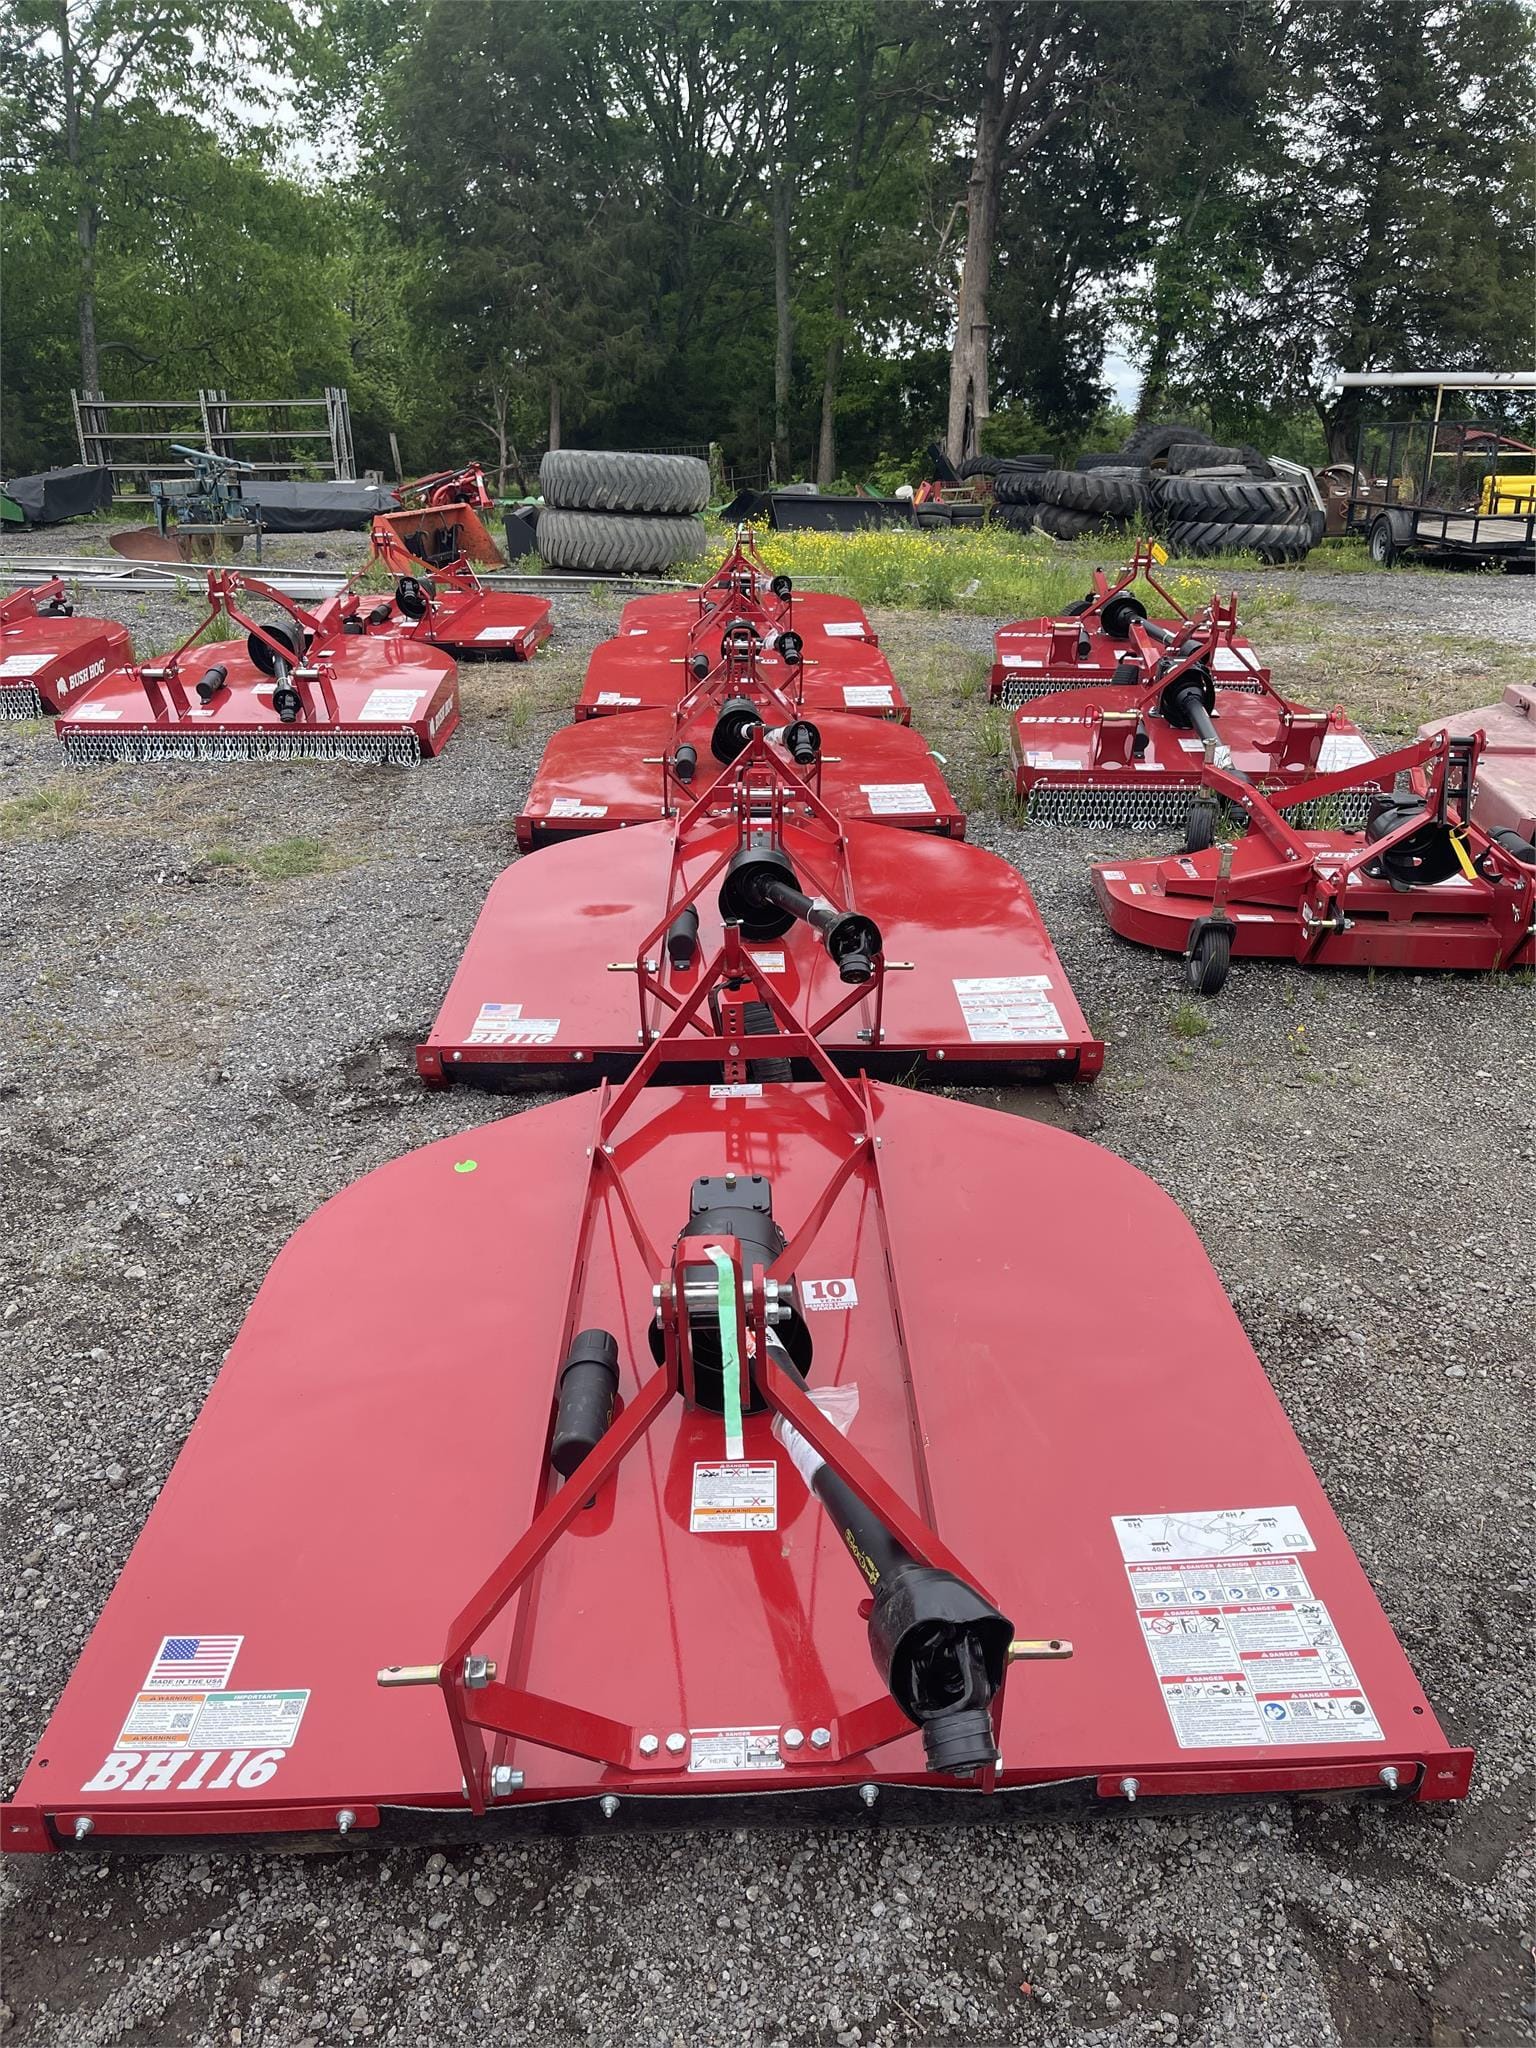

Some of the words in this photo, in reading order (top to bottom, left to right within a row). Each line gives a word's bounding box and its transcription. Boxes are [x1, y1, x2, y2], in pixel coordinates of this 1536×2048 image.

[68, 667, 89, 690] BUSH
[88, 659, 106, 680] HOG
[462, 1033, 555, 1044] BH116
[811, 1281, 847, 1299] 10
[80, 1748, 286, 1792] BH116
